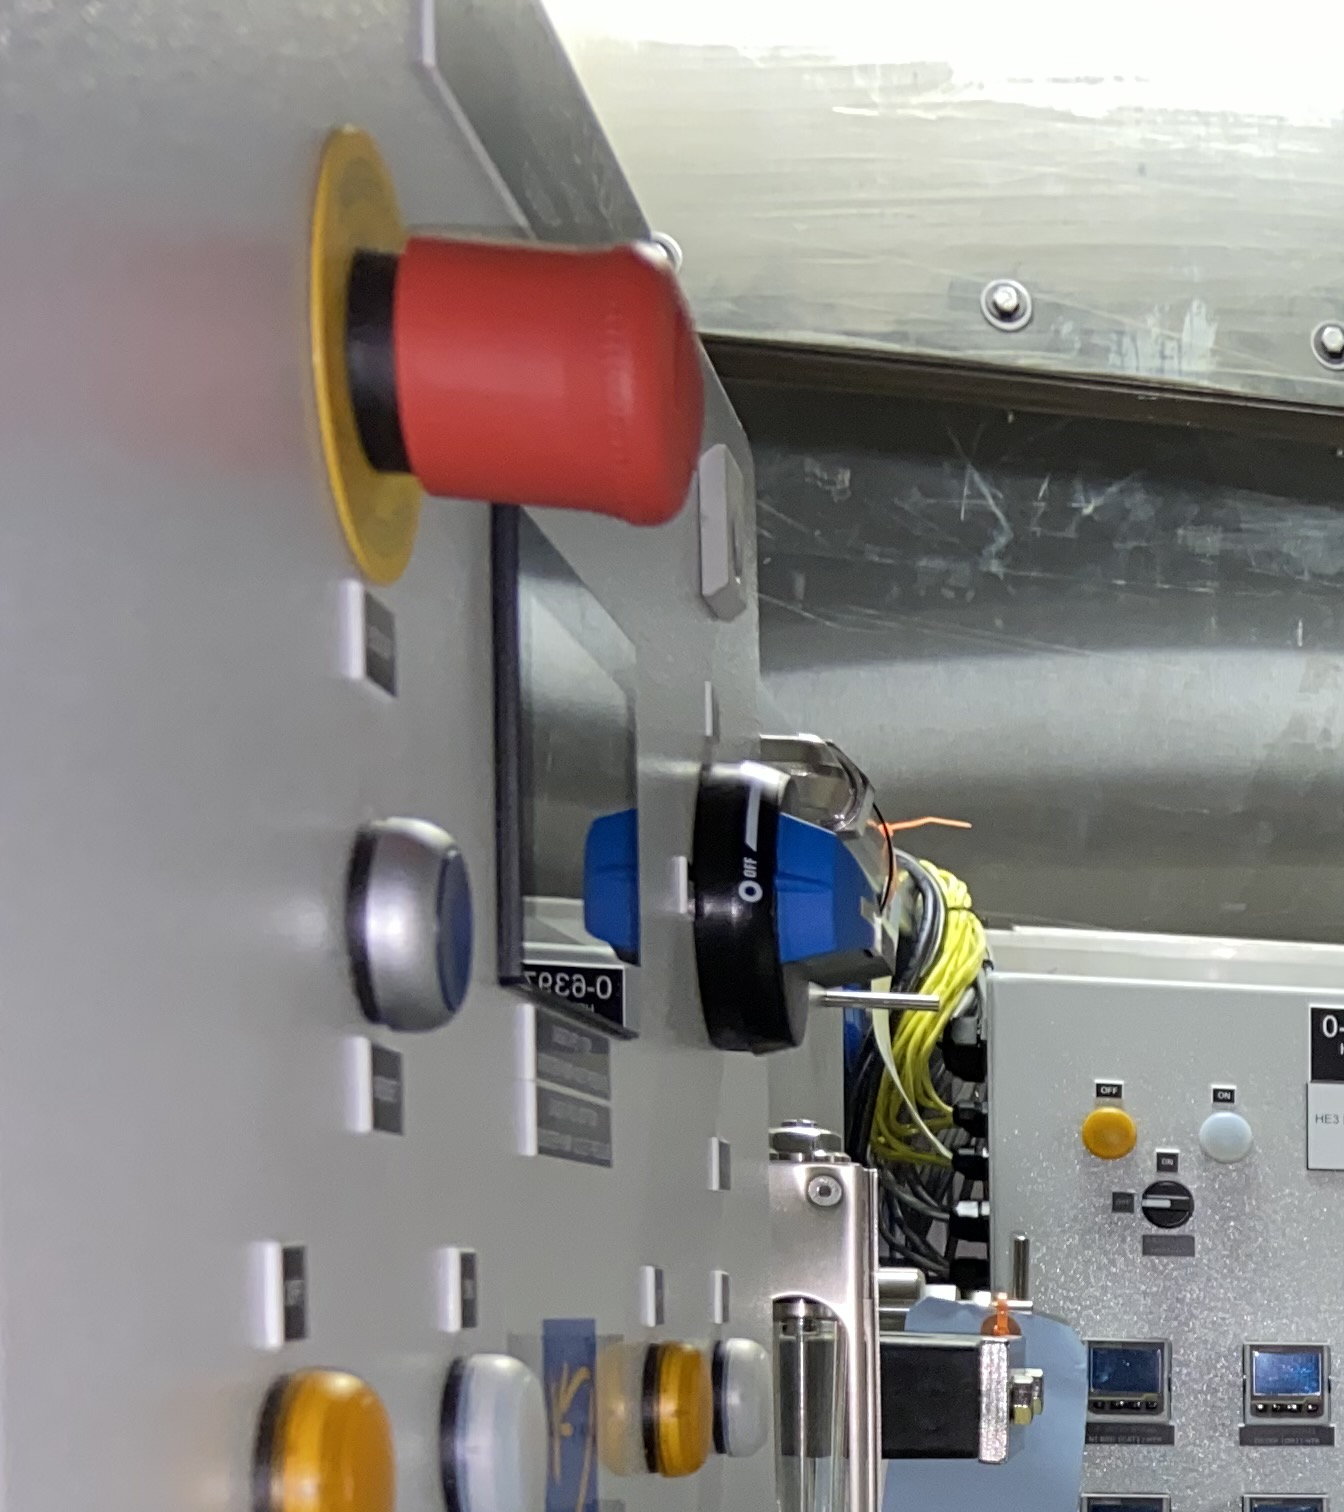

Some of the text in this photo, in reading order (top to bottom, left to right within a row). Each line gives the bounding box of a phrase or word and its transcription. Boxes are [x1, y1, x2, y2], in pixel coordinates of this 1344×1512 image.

[743, 856, 758, 878] OFF
[1101, 1086, 1118, 1095] OFF
[1217, 1092, 1231, 1100] ON
[1315, 1114, 1340, 1125] HE3
